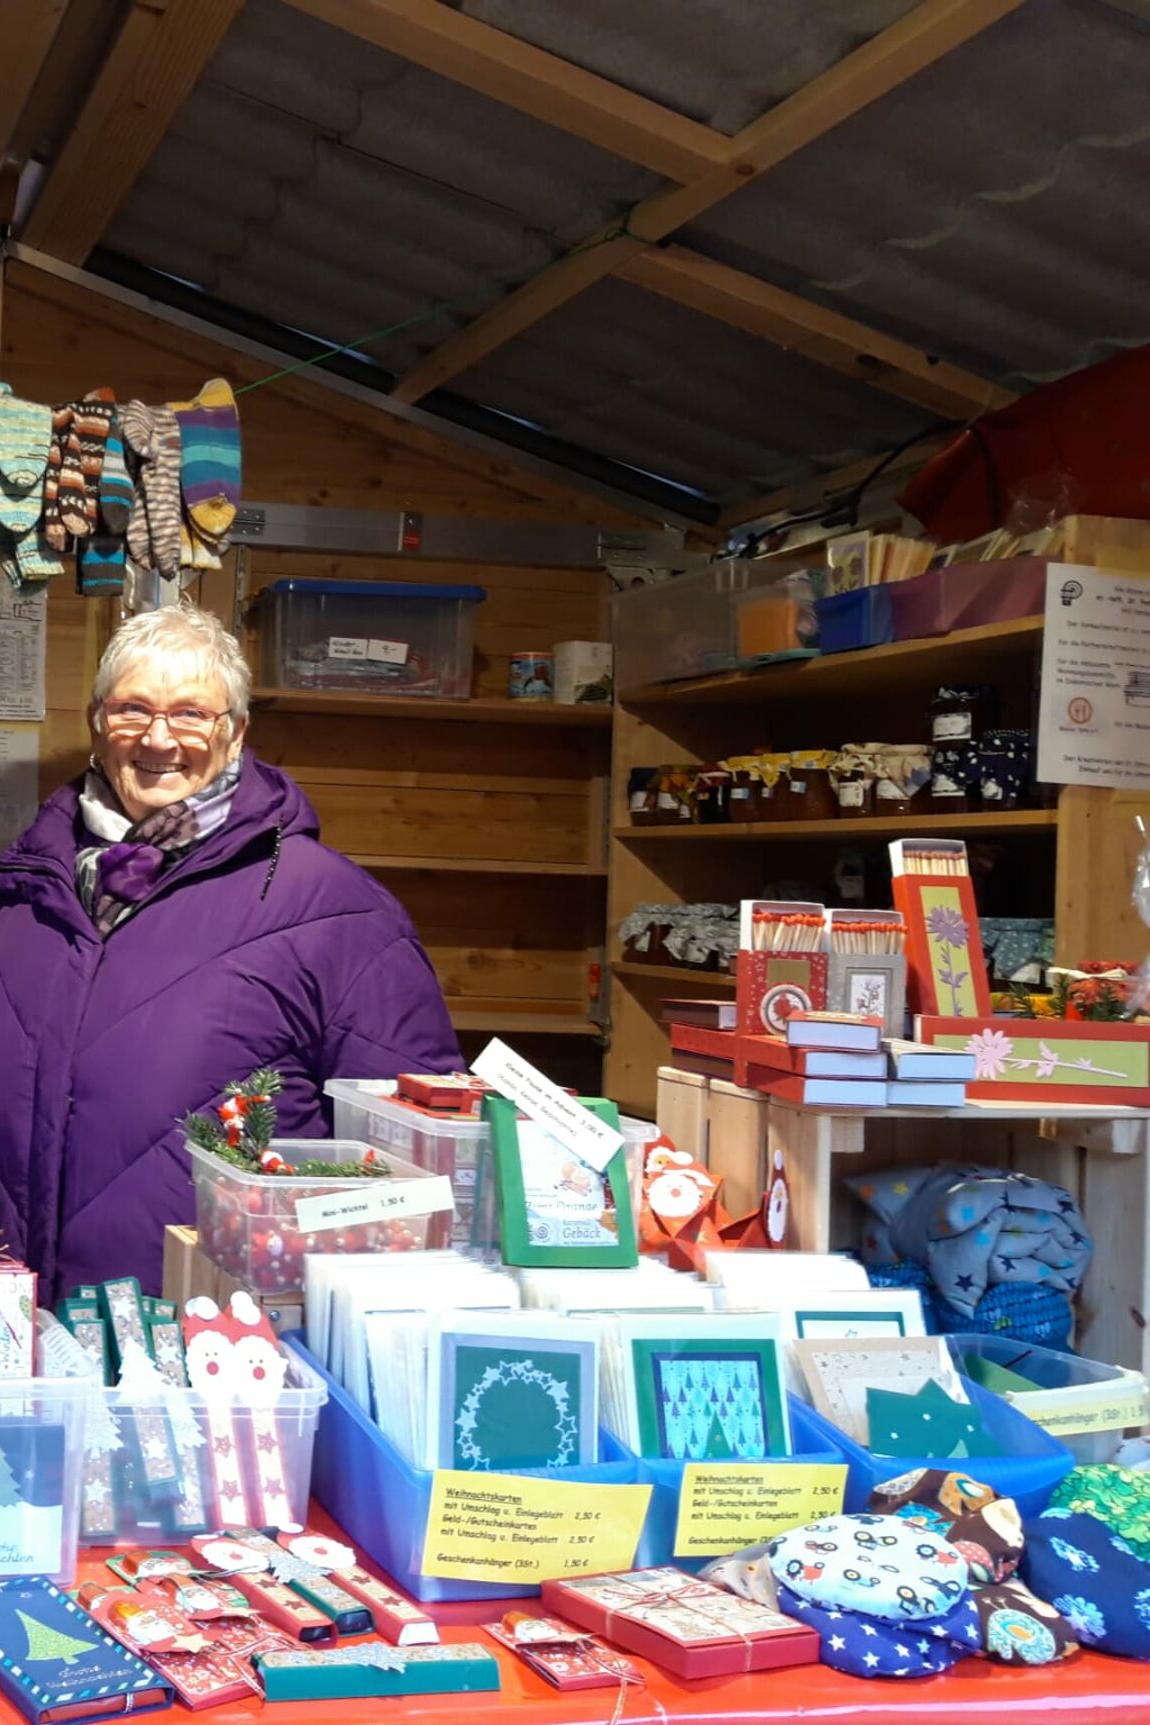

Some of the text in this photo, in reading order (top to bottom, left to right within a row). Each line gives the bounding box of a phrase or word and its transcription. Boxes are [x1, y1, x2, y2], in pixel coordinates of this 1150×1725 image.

[563, 1225, 602, 1239] Gebäck
[1033, 1412, 1099, 1427] schenkanhänger
[694, 1475, 764, 1484] Weihnachtskarten
[445, 1487, 522, 1503] Weihnachtskarten
[708, 1487, 744, 1497] Umschlag
[757, 1487, 802, 1497] Einlegeblatt
[812, 1486, 831, 1496] 2,50
[832, 1487, 839, 1495] €
[444, 1502, 457, 1510] mit
[461, 1501, 500, 1516] Umschlag
[515, 1507, 563, 1520] Einlegeblatt
[574, 1511, 593, 1521] 2,50
[594, 1512, 601, 1520] €
[691, 1512, 704, 1520] mit
[706, 1512, 742, 1522] Umschlag
[755, 1511, 799, 1522] Einlegeblatt
[442, 1514, 538, 1531] Geld-/Gutscheinkarten
[440, 1527, 454, 1536] mit
[457, 1528, 497, 1542] Umschlag
[512, 1533, 558, 1545] Einlegeblatt
[569, 1535, 587, 1545] 2,50
[588, 1535, 595, 1543] €
[688, 1537, 757, 1547] Geschenkanhänger
[437, 1553, 512, 1569] Geschenkanhänger
[582, 1559, 589, 1567] €
